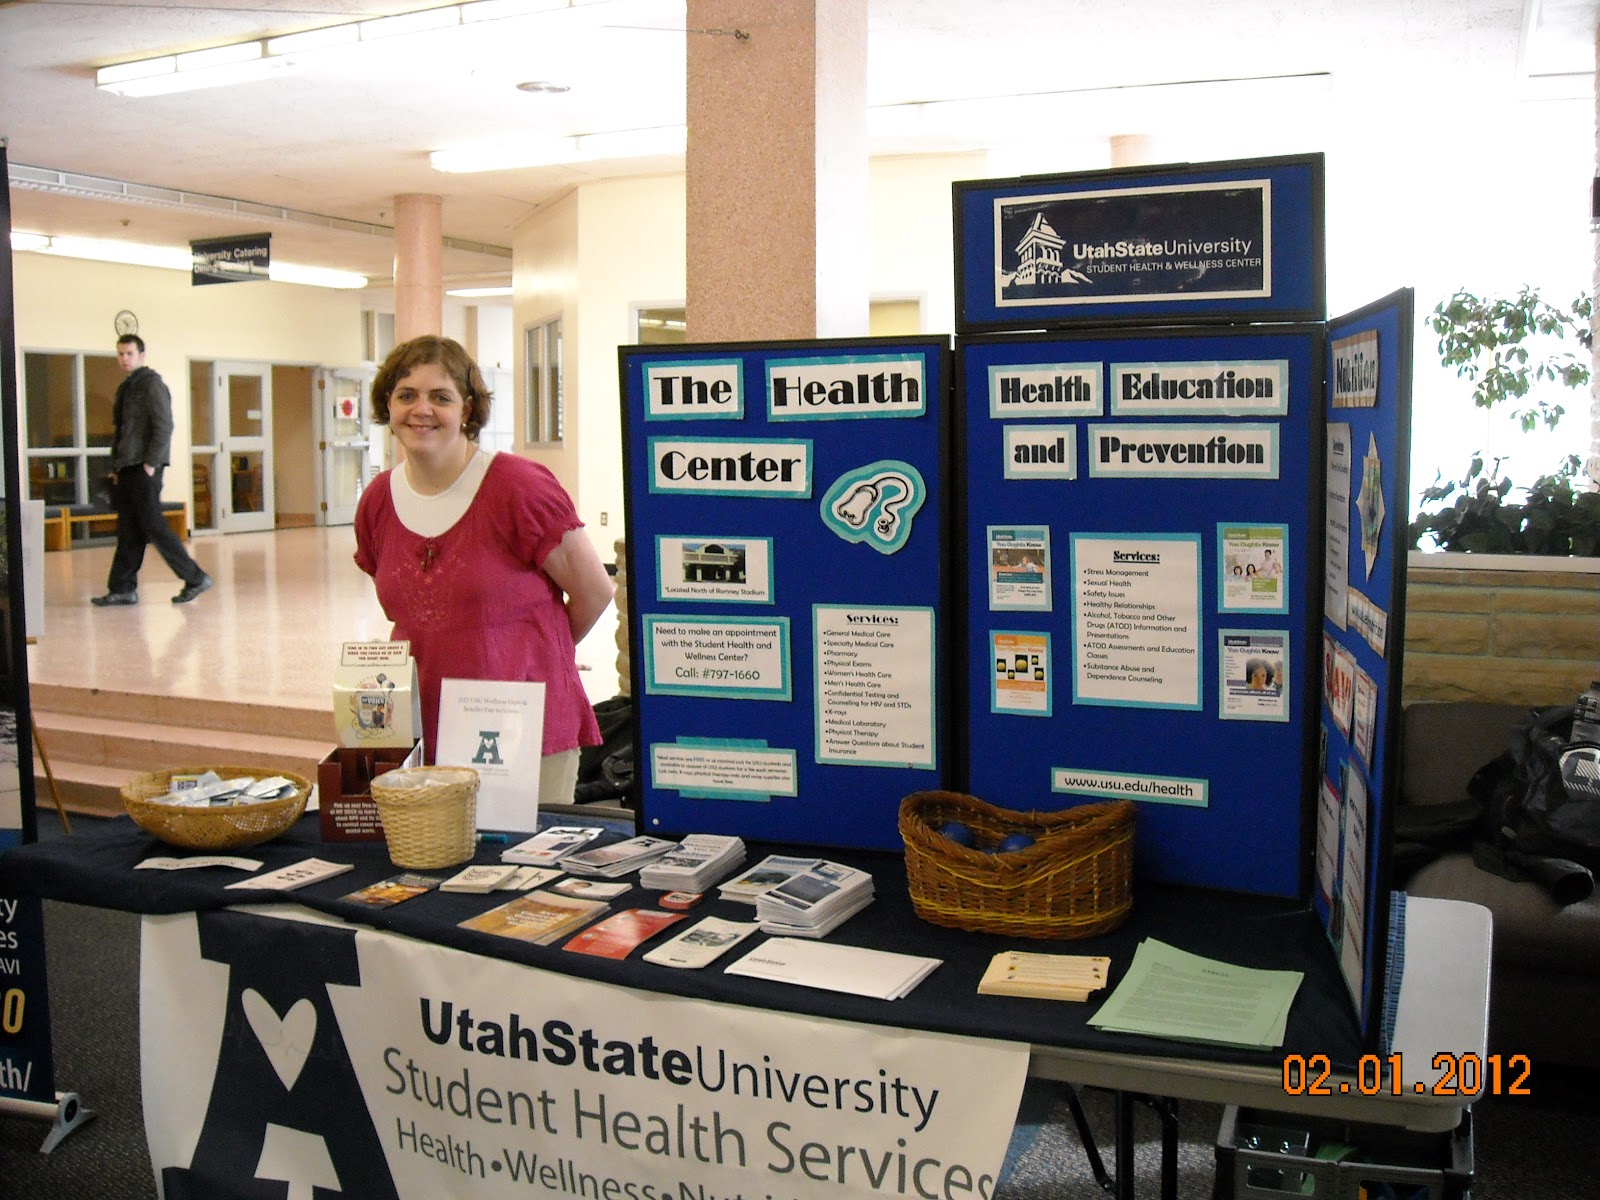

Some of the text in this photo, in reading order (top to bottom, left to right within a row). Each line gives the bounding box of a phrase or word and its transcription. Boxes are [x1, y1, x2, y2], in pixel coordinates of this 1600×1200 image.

[234, 247, 267, 259] Catering
[1073, 238, 1252, 260] UtahStateUniversity
[1087, 257, 1262, 274] STUDENT HEALTH & WELLNESS CENTER
[653, 372, 919, 407] The Health
[1000, 370, 1273, 404] Health Education
[1014, 435, 1264, 464] and Prevention
[660, 451, 801, 482] Center
[1114, 551, 1160, 561] Services:
[1106, 569, 1149, 577] Management
[716, 588, 740, 596] Romney
[1087, 590, 1107, 598] Safety
[1087, 601, 1155, 610] Healthy Relationships
[847, 614, 898, 624] Services:
[1142, 613, 1154, 621] and
[1156, 614, 1176, 622] Other
[1087, 621, 1105, 629] Drugs
[1134, 624, 1172, 632] Information
[656, 627, 676, 635] Need
[688, 628, 710, 636] make
[725, 629, 777, 638] appointment
[1087, 631, 1129, 640] Presentations
[662, 639, 772, 650] with the Student Health and
[827, 640, 853, 648] Specialty
[1087, 642, 1106, 650] ATOD
[1108, 643, 1146, 652] Assessments
[1162, 646, 1195, 654] Education
[685, 652, 748, 661] Wellness Center?
[827, 650, 858, 658] Pharmacy
[1087, 652, 1108, 660] Classes
[827, 660, 851, 668] Physical
[1087, 663, 1155, 673] Substance Abuse and
[675, 667, 760, 680] Call: #797-1660
[1087, 673, 1162, 684] Dependence Counseling
[865, 691, 885, 699] Testing
[828, 699, 859, 707] Counseling
[853, 720, 886, 728] Laboratory
[829, 728, 878, 738] Physical Therapy
[829, 747, 856, 755] Insurance
[901, 742, 924, 750] Student
[1065, 777, 1193, 797] www.usu.edu/health
[420, 997, 938, 1133] UtahStateUniversity
[383, 1046, 557, 1135] Student
[574, 1088, 745, 1167] Health
